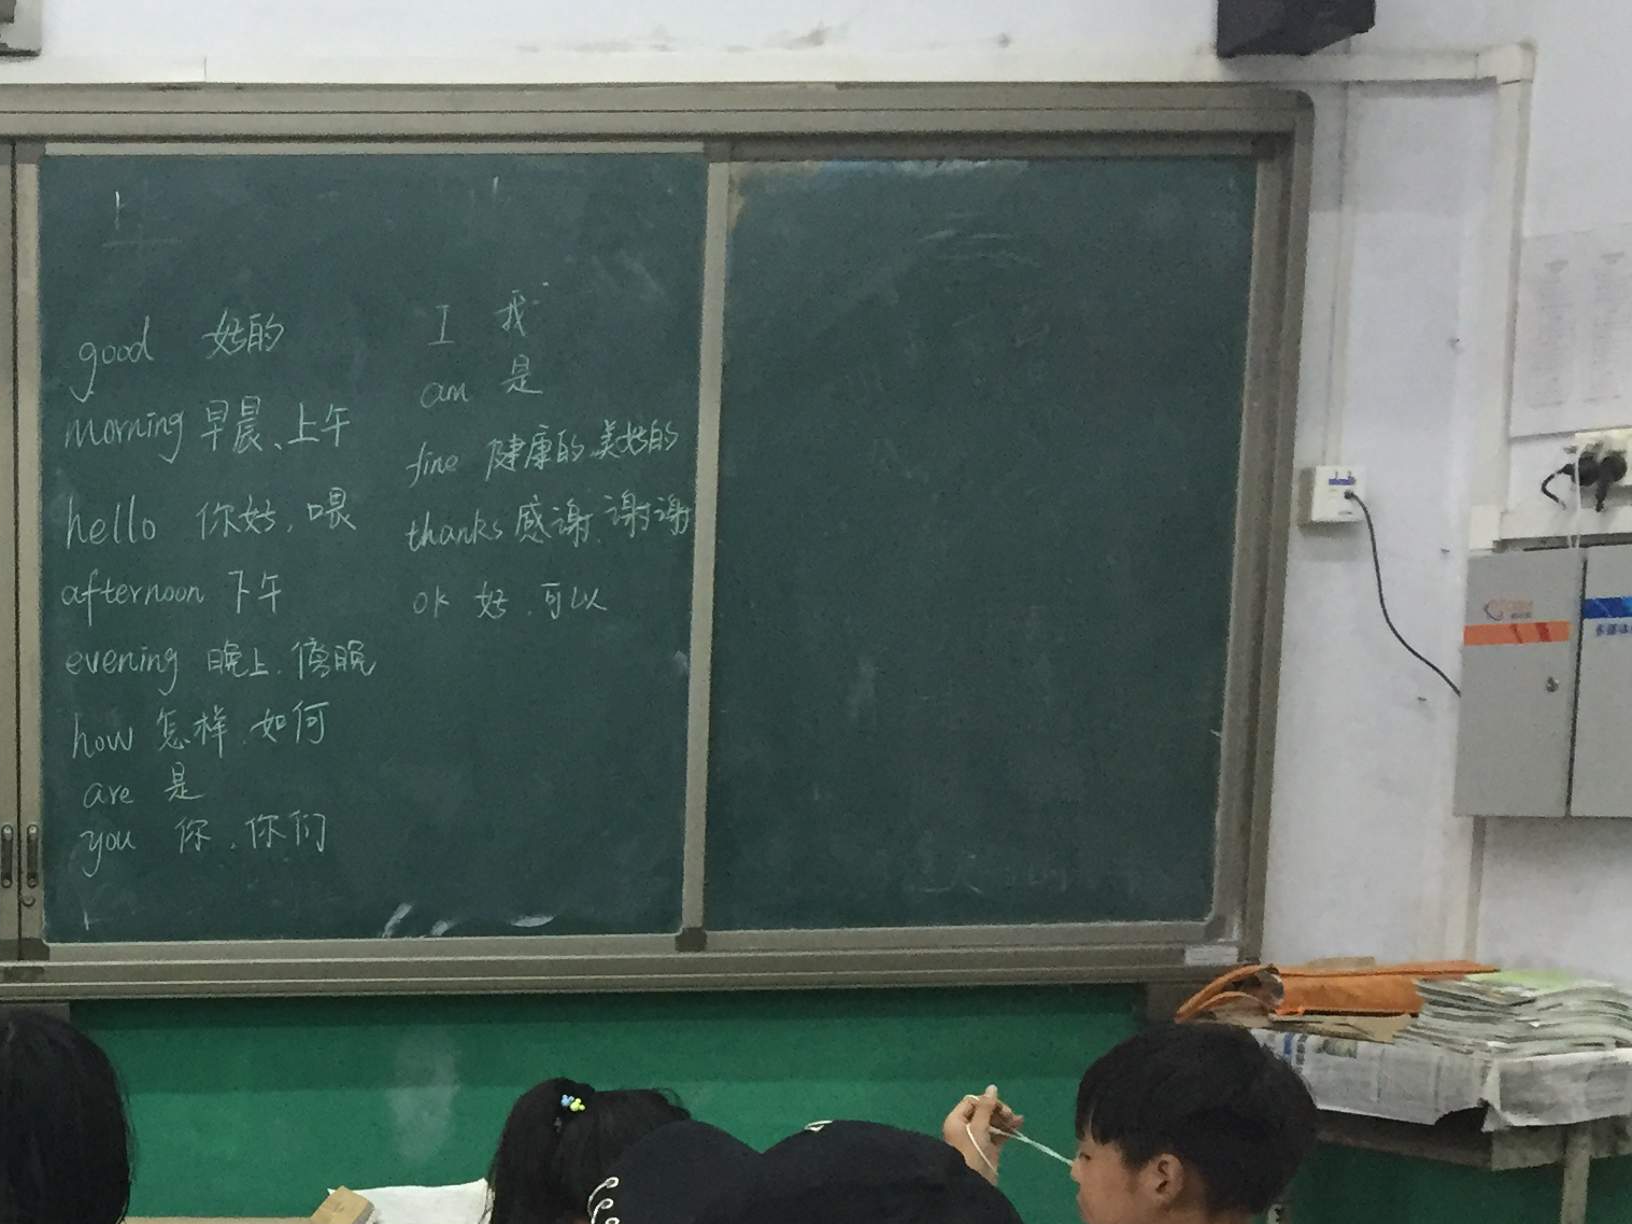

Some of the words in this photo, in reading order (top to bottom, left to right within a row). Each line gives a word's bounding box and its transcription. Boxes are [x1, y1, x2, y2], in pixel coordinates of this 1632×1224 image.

[68, 315, 155, 404] good
[420, 381, 472, 409] am
[500, 353, 543, 395] 是
[65, 410, 184, 464] morning
[406, 441, 459, 489] fine
[67, 494, 157, 549] hello
[406, 510, 504, 554] thanks
[61, 568, 205, 627] afternoon
[228, 570, 282, 614] 下午
[65, 646, 180, 696] evening
[72, 713, 134, 760] how
[83, 782, 135, 809] are
[164, 762, 205, 803] 是
[80, 828, 137, 878] you
